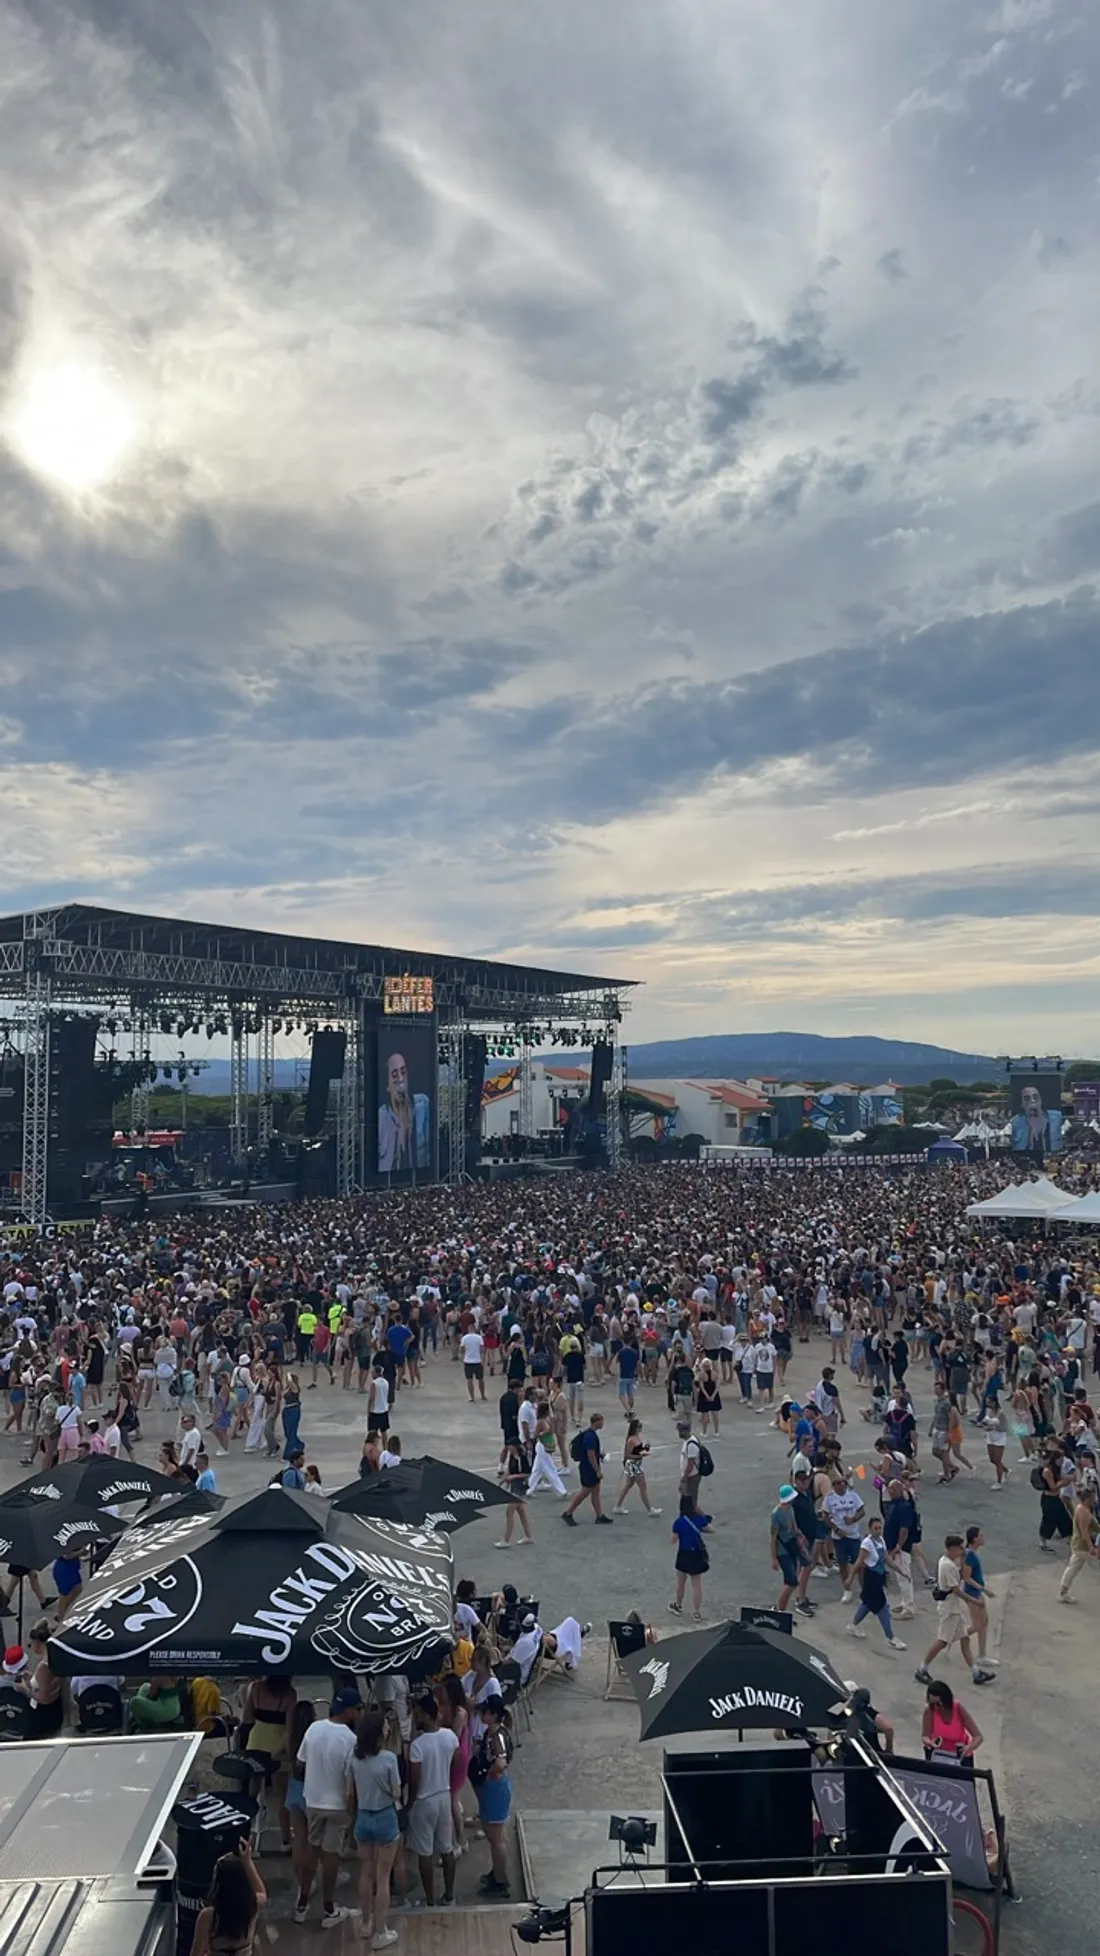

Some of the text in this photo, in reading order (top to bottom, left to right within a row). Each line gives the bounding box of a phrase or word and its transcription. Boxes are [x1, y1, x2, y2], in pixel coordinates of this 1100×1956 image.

[384, 995, 433, 1014] LANTES
[45, 1226, 55, 1239] C
[97, 1480, 152, 1501] JACK DANIEL'S
[231, 1566, 328, 1664] JACK
[304, 1541, 449, 1592] DANIEL'S
[124, 1596, 178, 1632] 7
[149, 1650, 169, 1659] PLEASE
[708, 1686, 804, 1719] JACK DANIEL'S
